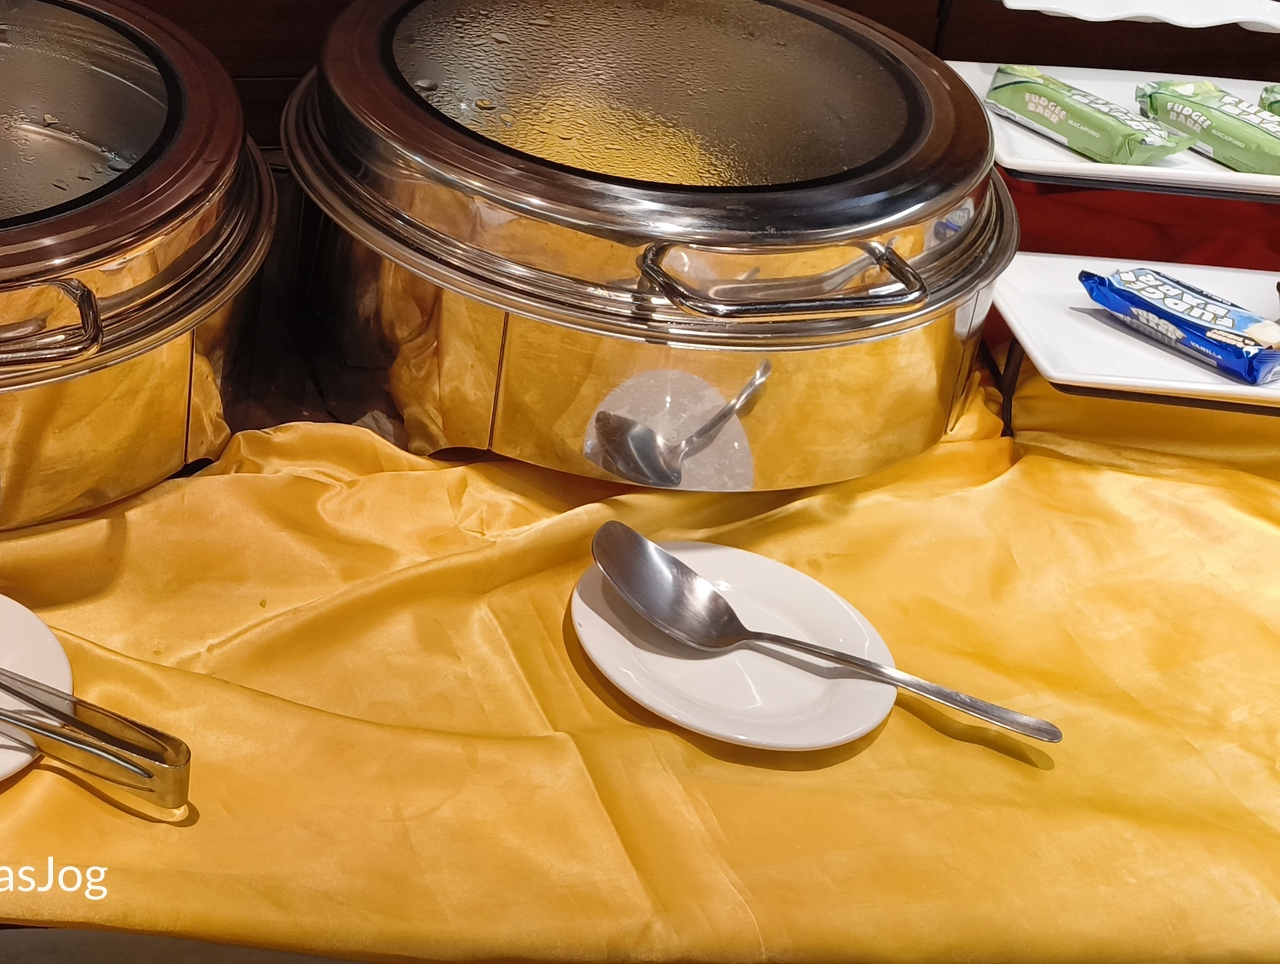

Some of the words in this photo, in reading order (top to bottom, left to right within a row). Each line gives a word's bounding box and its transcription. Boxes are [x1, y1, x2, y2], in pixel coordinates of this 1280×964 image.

[1024, 92, 1068, 120] FUDGEE
[1027, 102, 1061, 125] BARR
[1166, 101, 1213, 130] FUDGEE
[1190, 340, 1223, 360] VANILLA
